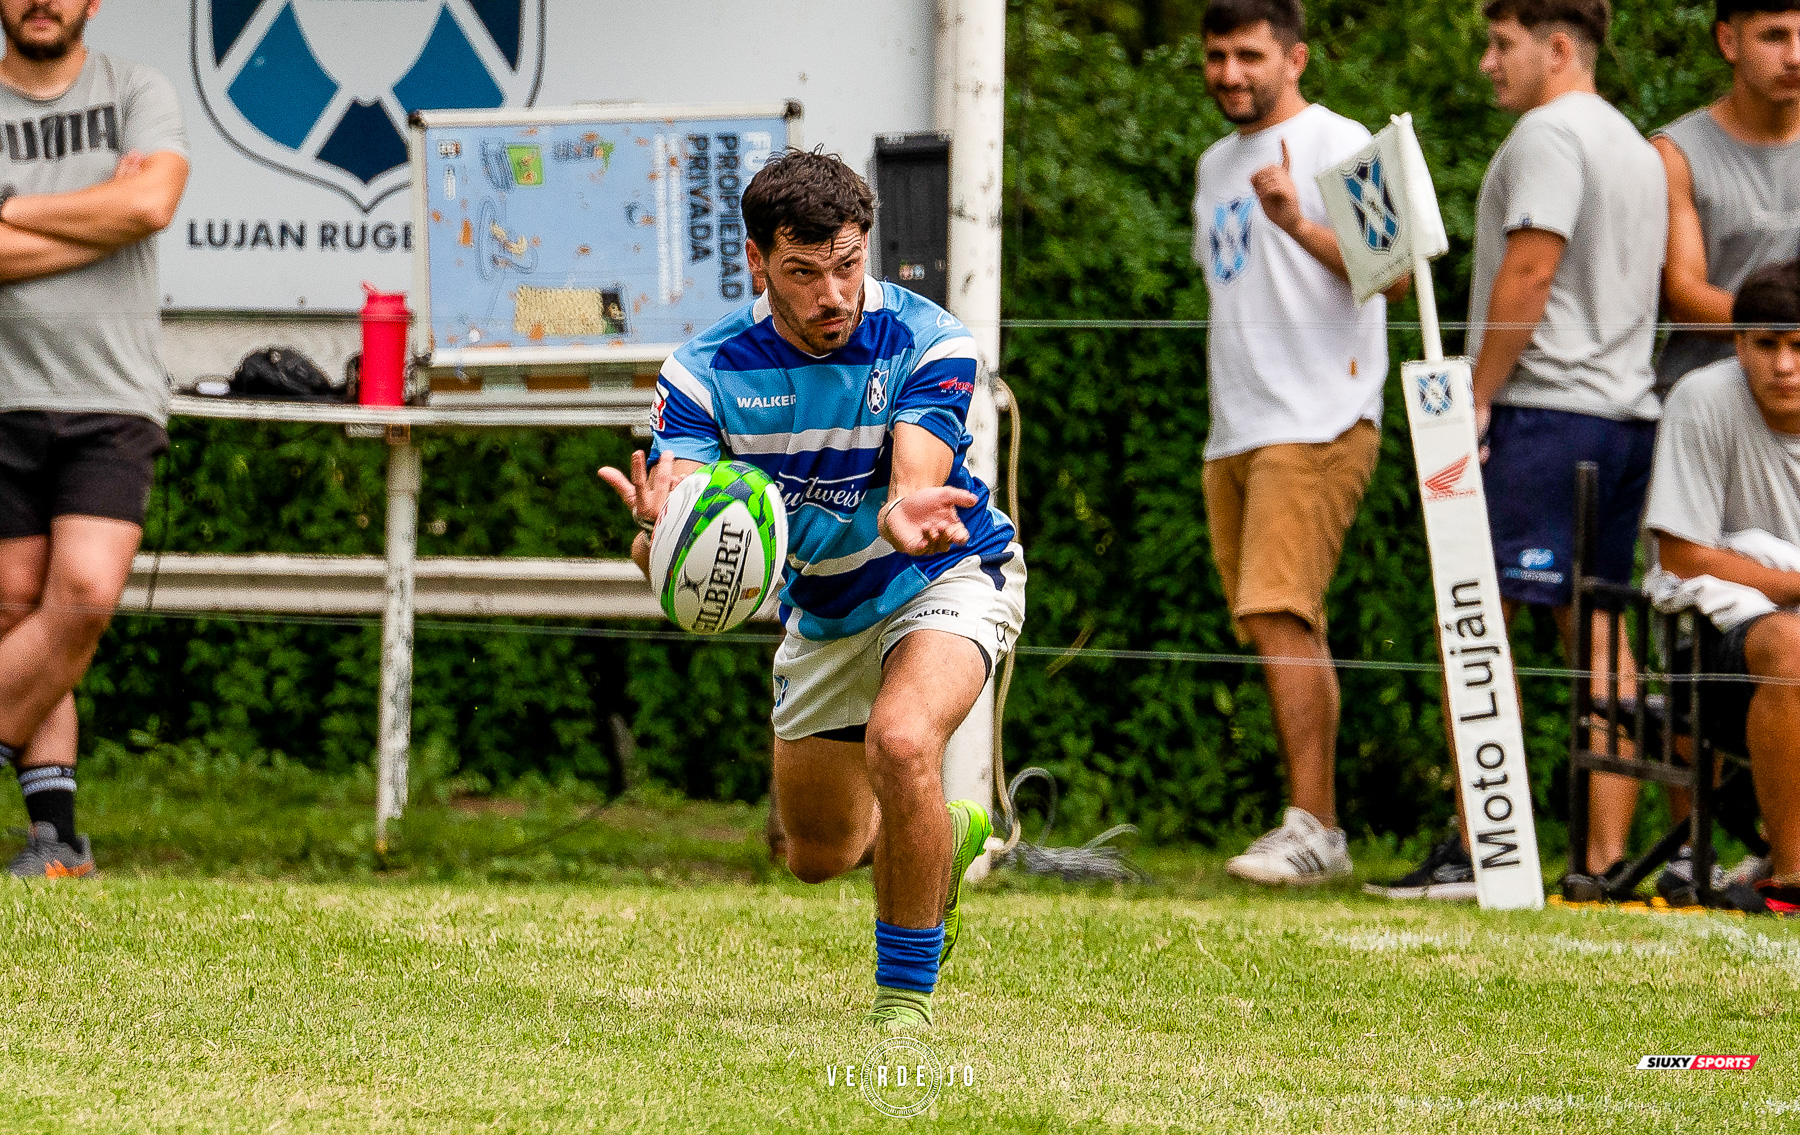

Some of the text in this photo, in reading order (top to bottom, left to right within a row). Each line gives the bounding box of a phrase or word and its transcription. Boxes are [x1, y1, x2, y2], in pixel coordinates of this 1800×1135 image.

[0, 105, 119, 161] UMA
[188, 221, 306, 250] LUJAN
[687, 133, 712, 263] PRIVADA
[717, 133, 743, 301] PROPIEDAD
[902, 608, 960, 622] ALKER
[1445, 579, 1521, 870] Moto Luján
